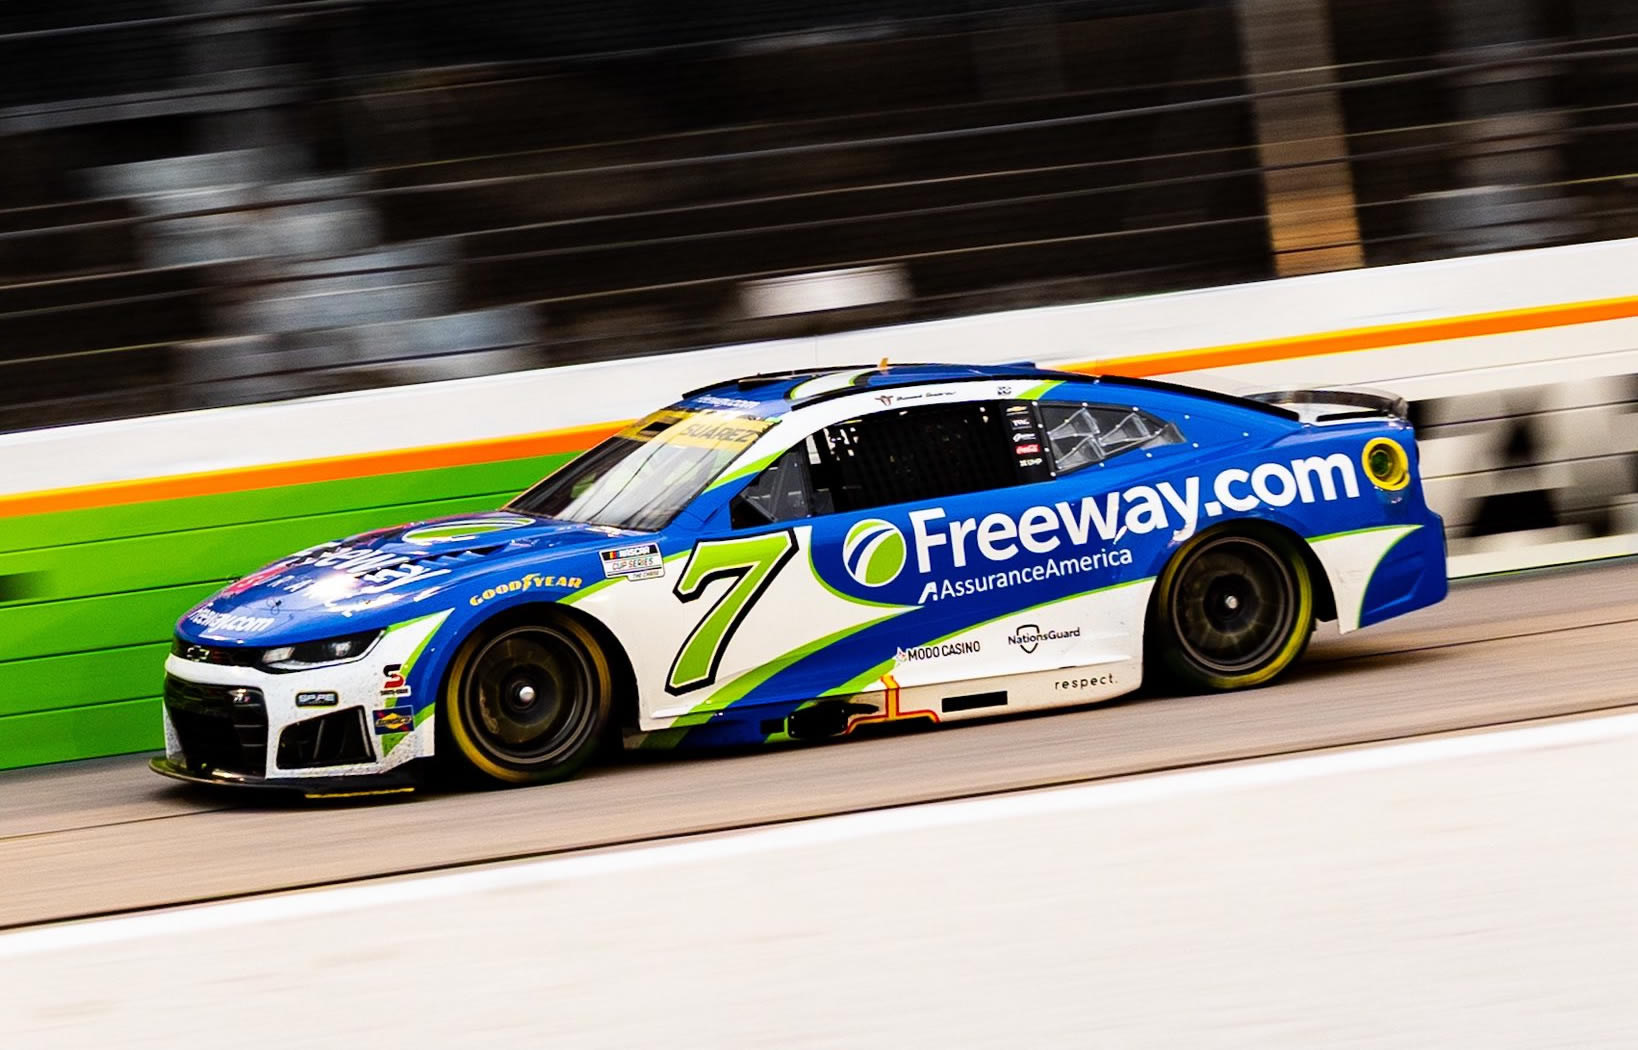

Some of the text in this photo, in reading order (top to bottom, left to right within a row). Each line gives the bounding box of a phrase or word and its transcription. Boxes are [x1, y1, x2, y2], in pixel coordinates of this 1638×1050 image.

[908, 452, 1360, 574] Freeway.com
[469, 573, 583, 607] GOODYEAR
[940, 547, 1134, 600] AssuranceAmerica
[664, 526, 799, 697] 7
[907, 641, 981, 662] MODO CASINO
[1007, 627, 1081, 646] NationsGuard
[1054, 673, 1118, 691] respect.
